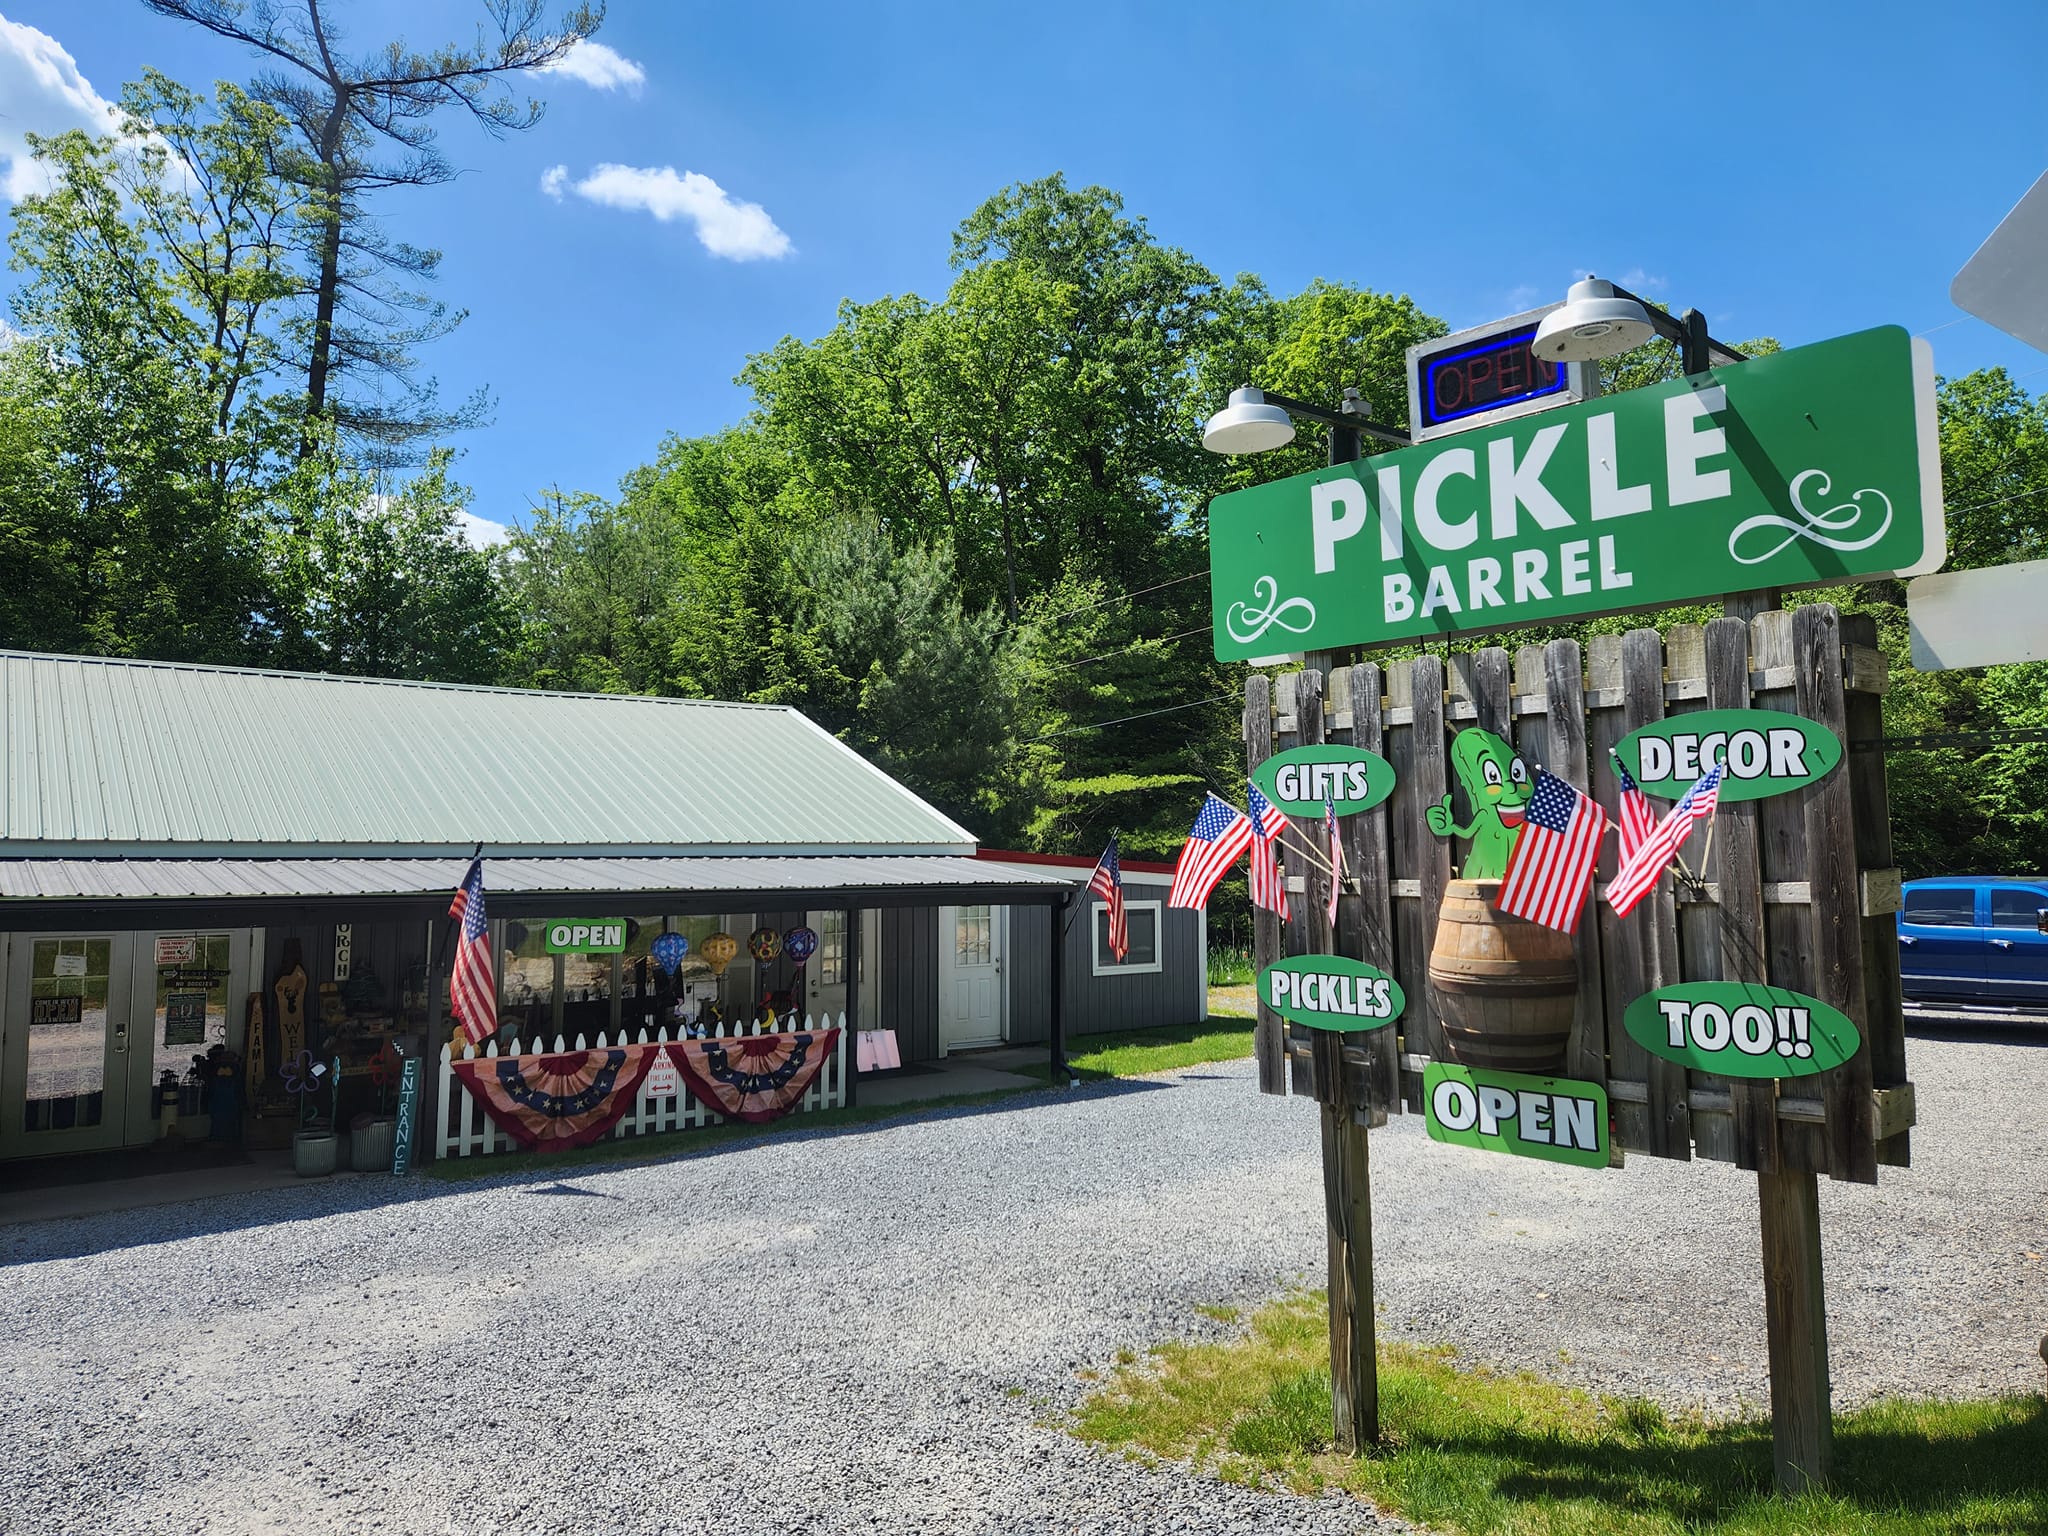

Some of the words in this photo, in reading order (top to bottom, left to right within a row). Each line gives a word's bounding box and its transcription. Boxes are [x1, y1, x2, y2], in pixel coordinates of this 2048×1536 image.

[1436, 343, 1556, 409] OPEN
[1311, 384, 1731, 574] PICKLE
[1383, 535, 1633, 624] BARREL
[1275, 761, 1368, 801] GIFTS
[1638, 728, 1809, 781] DECOR
[550, 925, 622, 947] OPEN
[1270, 970, 1393, 1018] PICKLES
[1659, 1001, 1813, 1059] TOO!!
[653, 1062, 675, 1070] ARKIN
[662, 1073, 674, 1081] LANE
[393, 1059, 416, 1176] ENTRANCE
[1433, 1080, 1600, 1152] OPEN
